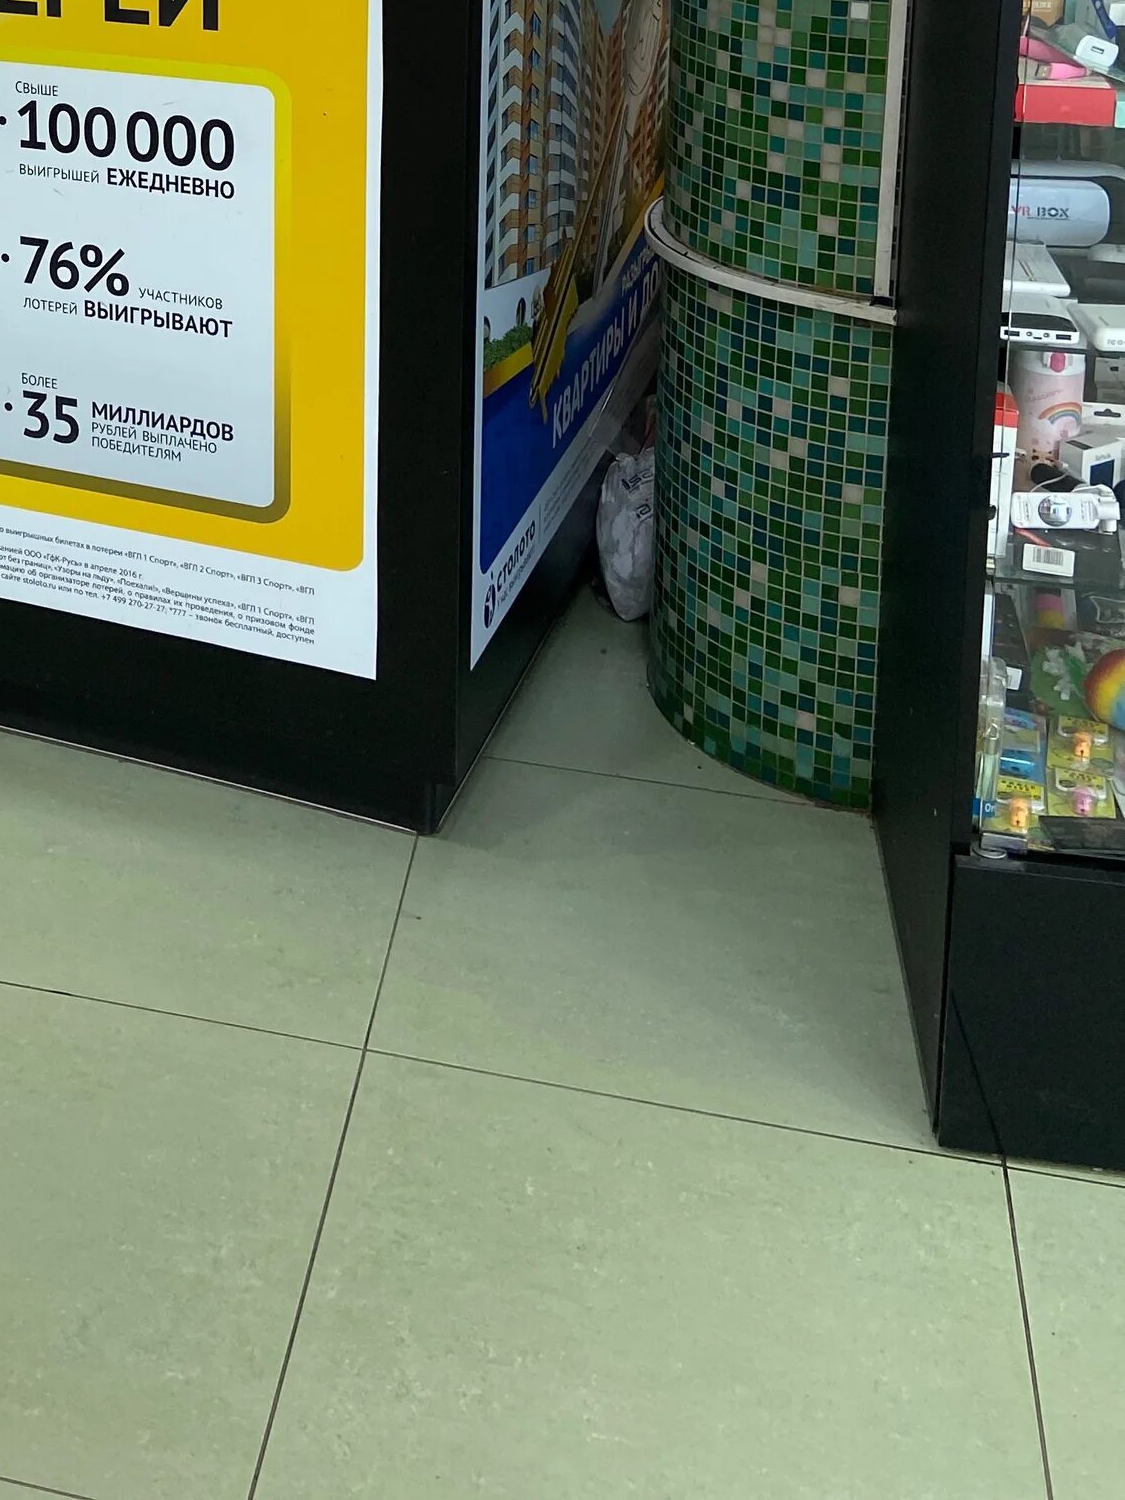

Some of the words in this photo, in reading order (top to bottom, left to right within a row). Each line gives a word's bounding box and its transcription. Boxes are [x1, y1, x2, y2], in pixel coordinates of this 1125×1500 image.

[16, 80, 58, 97] СВЫШЕ
[17, 99, 116, 158] 100
[126, 111, 235, 171] 000
[19, 163, 99, 184] ВЫИГРЫШЕЙ
[107, 167, 235, 199] ЕЖЕДНЕВНО
[1037, 207, 1069, 218] BOX
[19, 236, 129, 296] 76%
[139, 287, 223, 310] УЧАСТНИКОВ
[23, 297, 78, 315] ЛОТЕРЕЙ
[84, 300, 233, 338] ВЫИГРЫВАЮТ
[21, 372, 58, 389] БОЛЕЕ
[551, 323, 625, 449] КВАРТИРЫ
[627, 297, 640, 339] И
[23, 390, 79, 444] 35
[92, 401, 234, 442] МИЛЛИАРДОВ
[91, 422, 137, 439] РУБЛЕЙ
[143, 430, 217, 454] ВЫПЛАЧЕНО
[91, 435, 182, 462] ПОБЕДИТЕЛЯМ
[496, 520, 537, 589] СТОЛОТО
